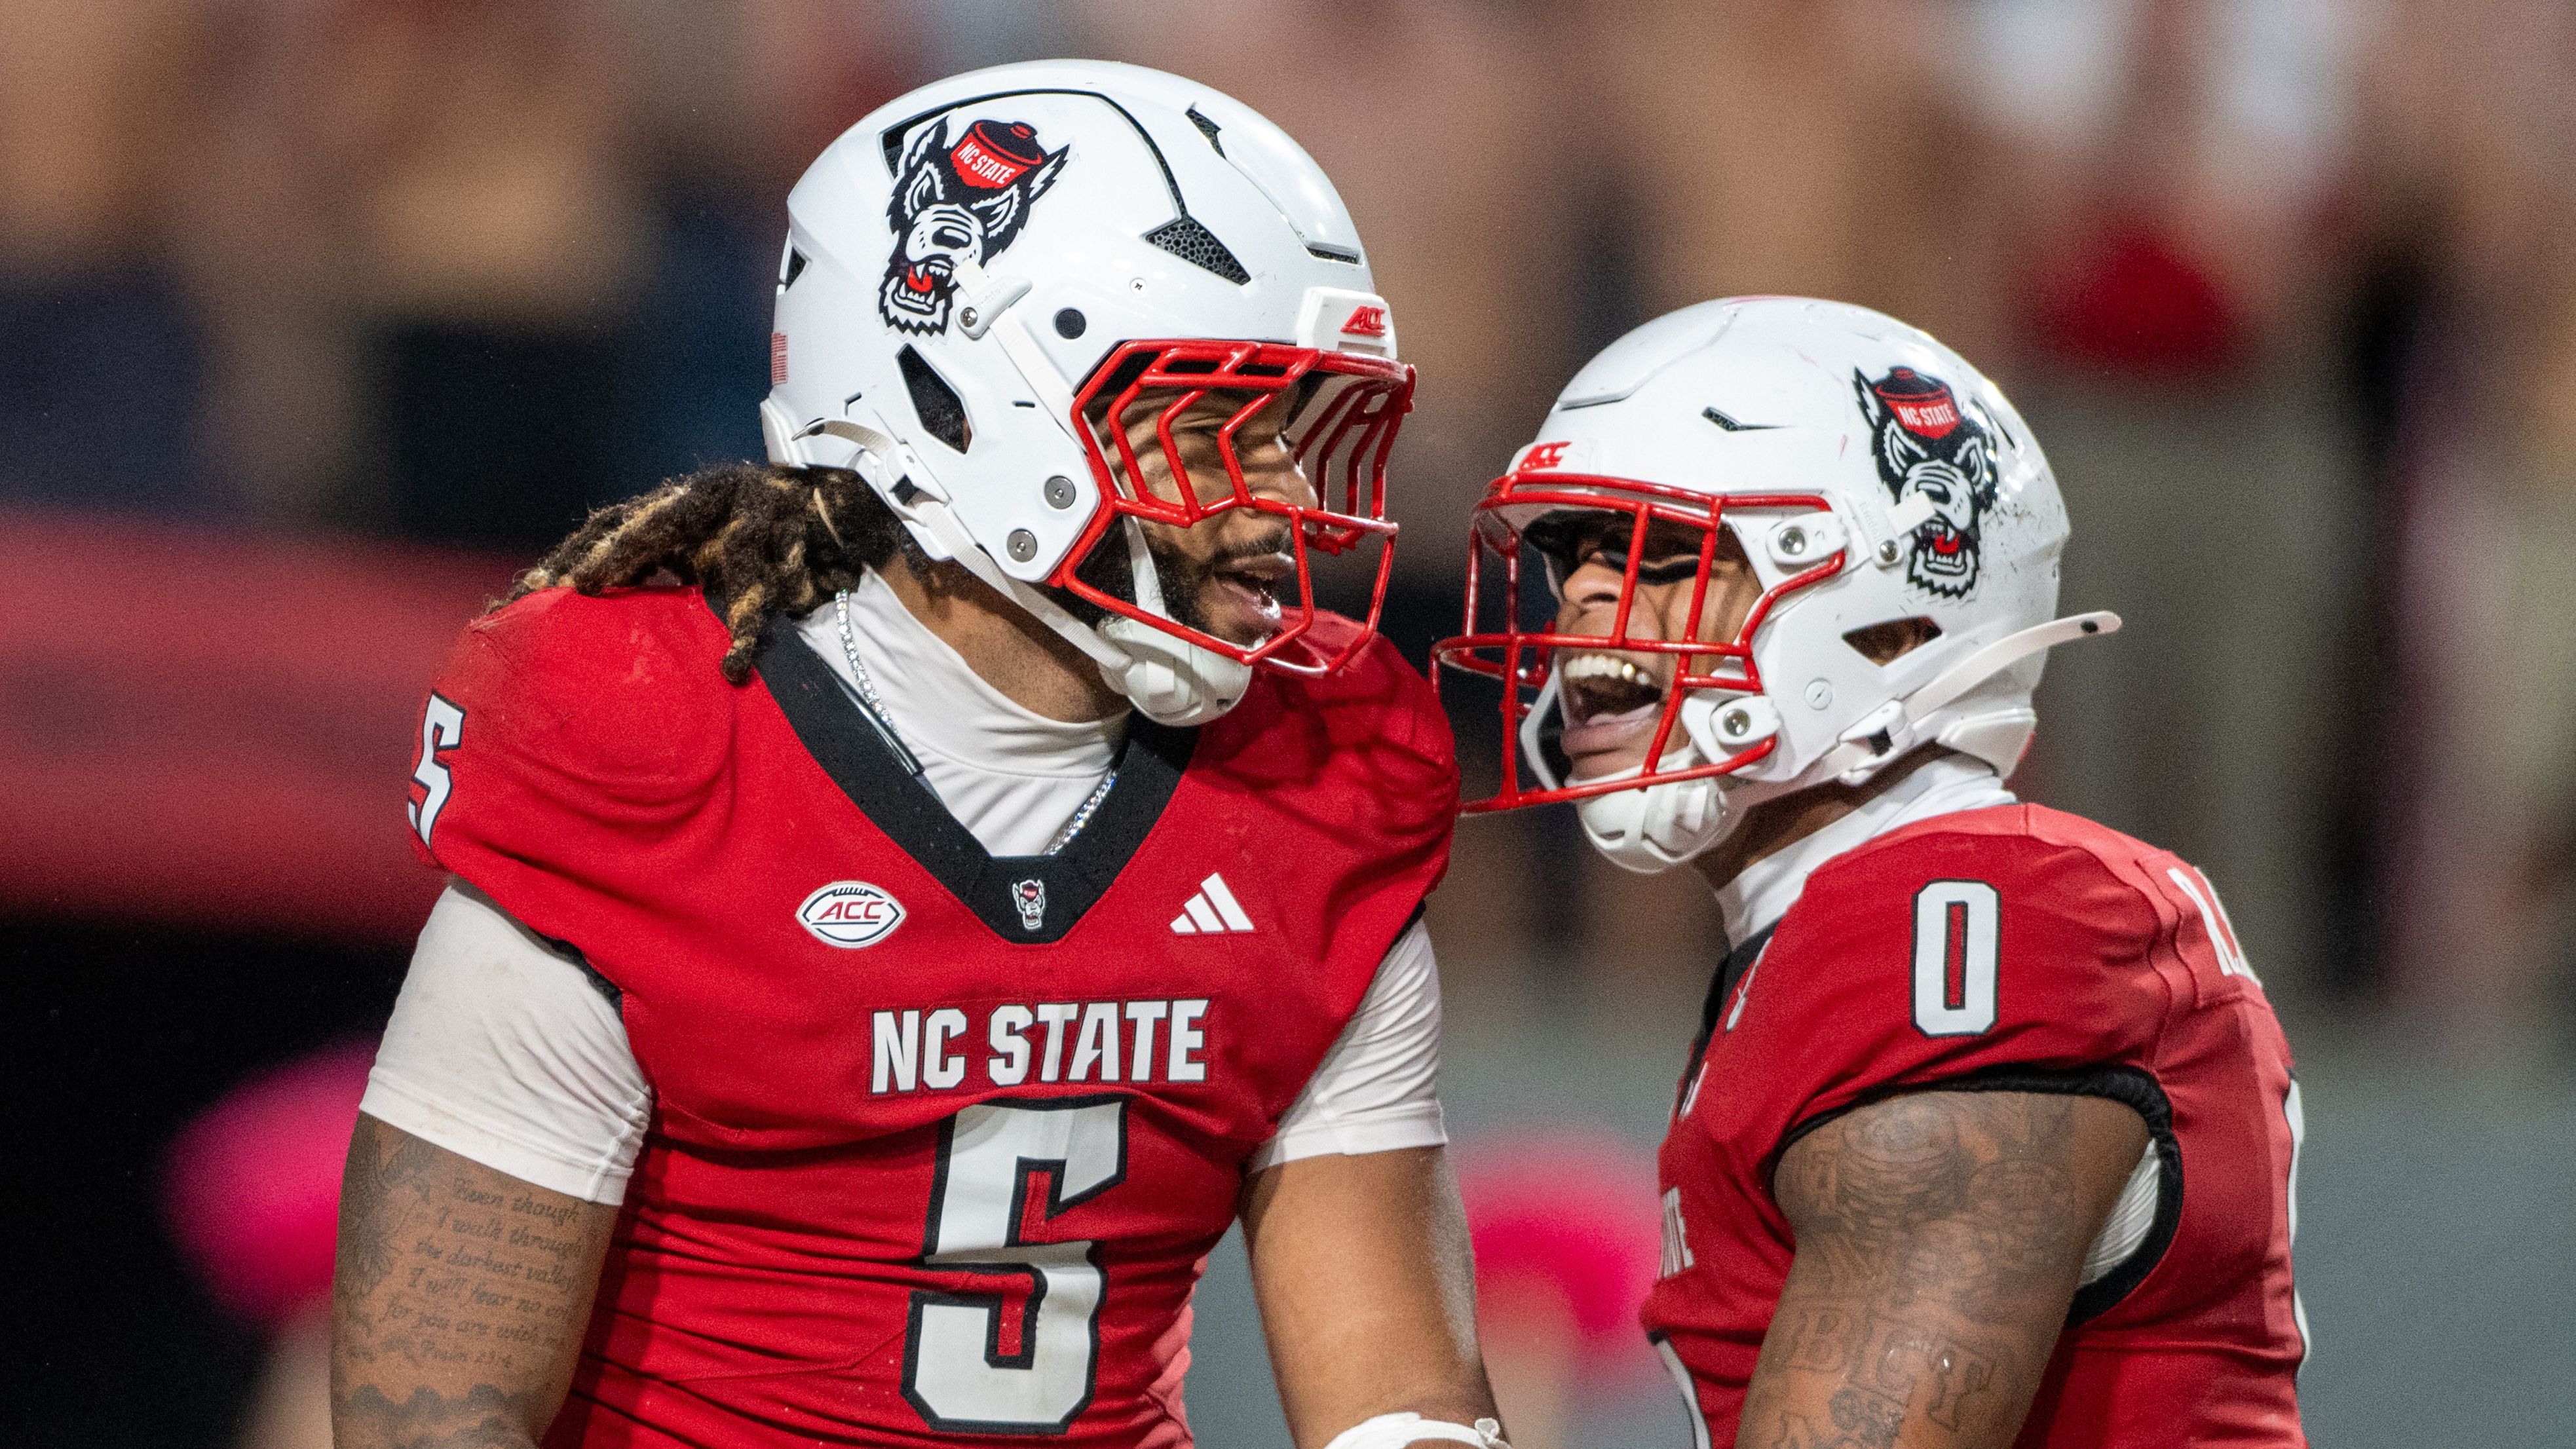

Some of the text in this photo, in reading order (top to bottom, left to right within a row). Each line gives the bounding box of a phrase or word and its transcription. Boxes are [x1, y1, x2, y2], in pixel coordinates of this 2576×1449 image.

[957, 141, 1016, 184] NC STATE
[1340, 305, 1386, 331] ACC
[1898, 403, 1956, 426] NC STATE
[407, 689, 467, 850] 5
[817, 901, 886, 920] ACC
[1909, 877, 2002, 1039] 0
[871, 998, 1211, 1095] NC STATE
[512, 1193, 580, 1226] though
[510, 1226, 582, 1260] through
[447, 1246, 523, 1277] darkest
[900, 1093, 1128, 1435] 5
